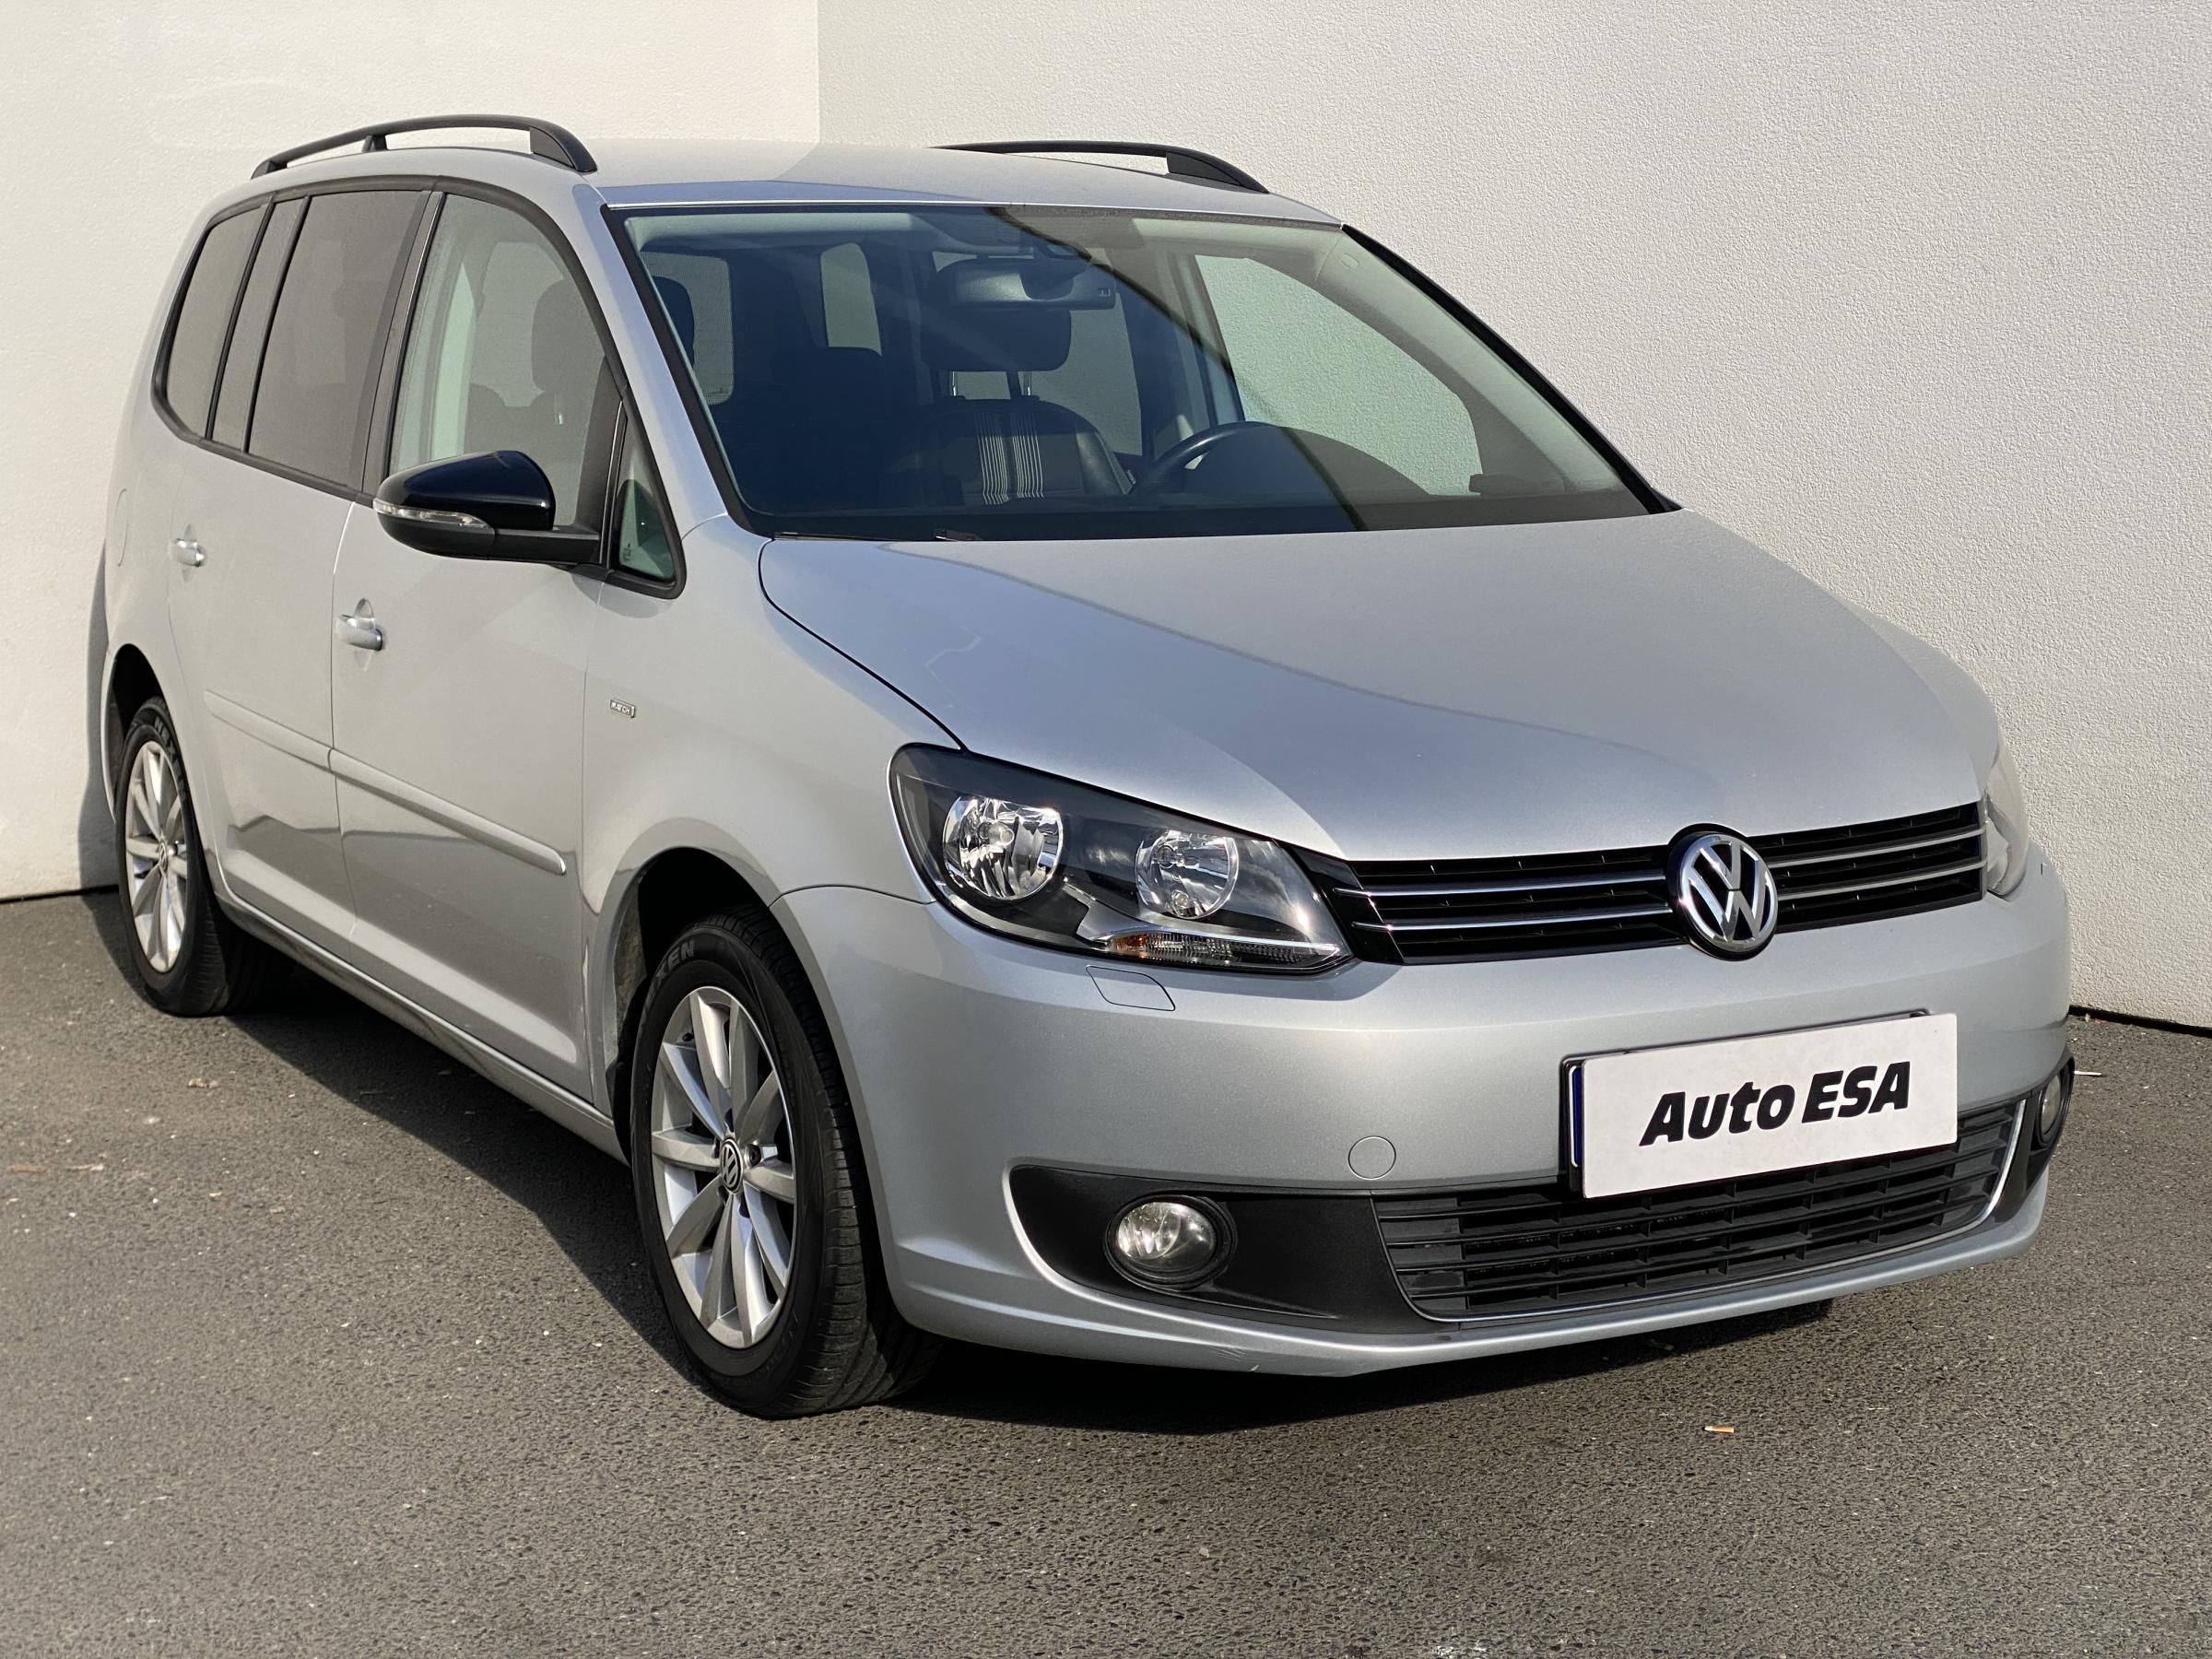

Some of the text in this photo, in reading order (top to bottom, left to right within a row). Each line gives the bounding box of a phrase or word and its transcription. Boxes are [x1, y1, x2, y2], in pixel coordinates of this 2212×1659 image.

[1680, 834, 1778, 952] VW
[1639, 1061, 1910, 1147] Auto ESA
